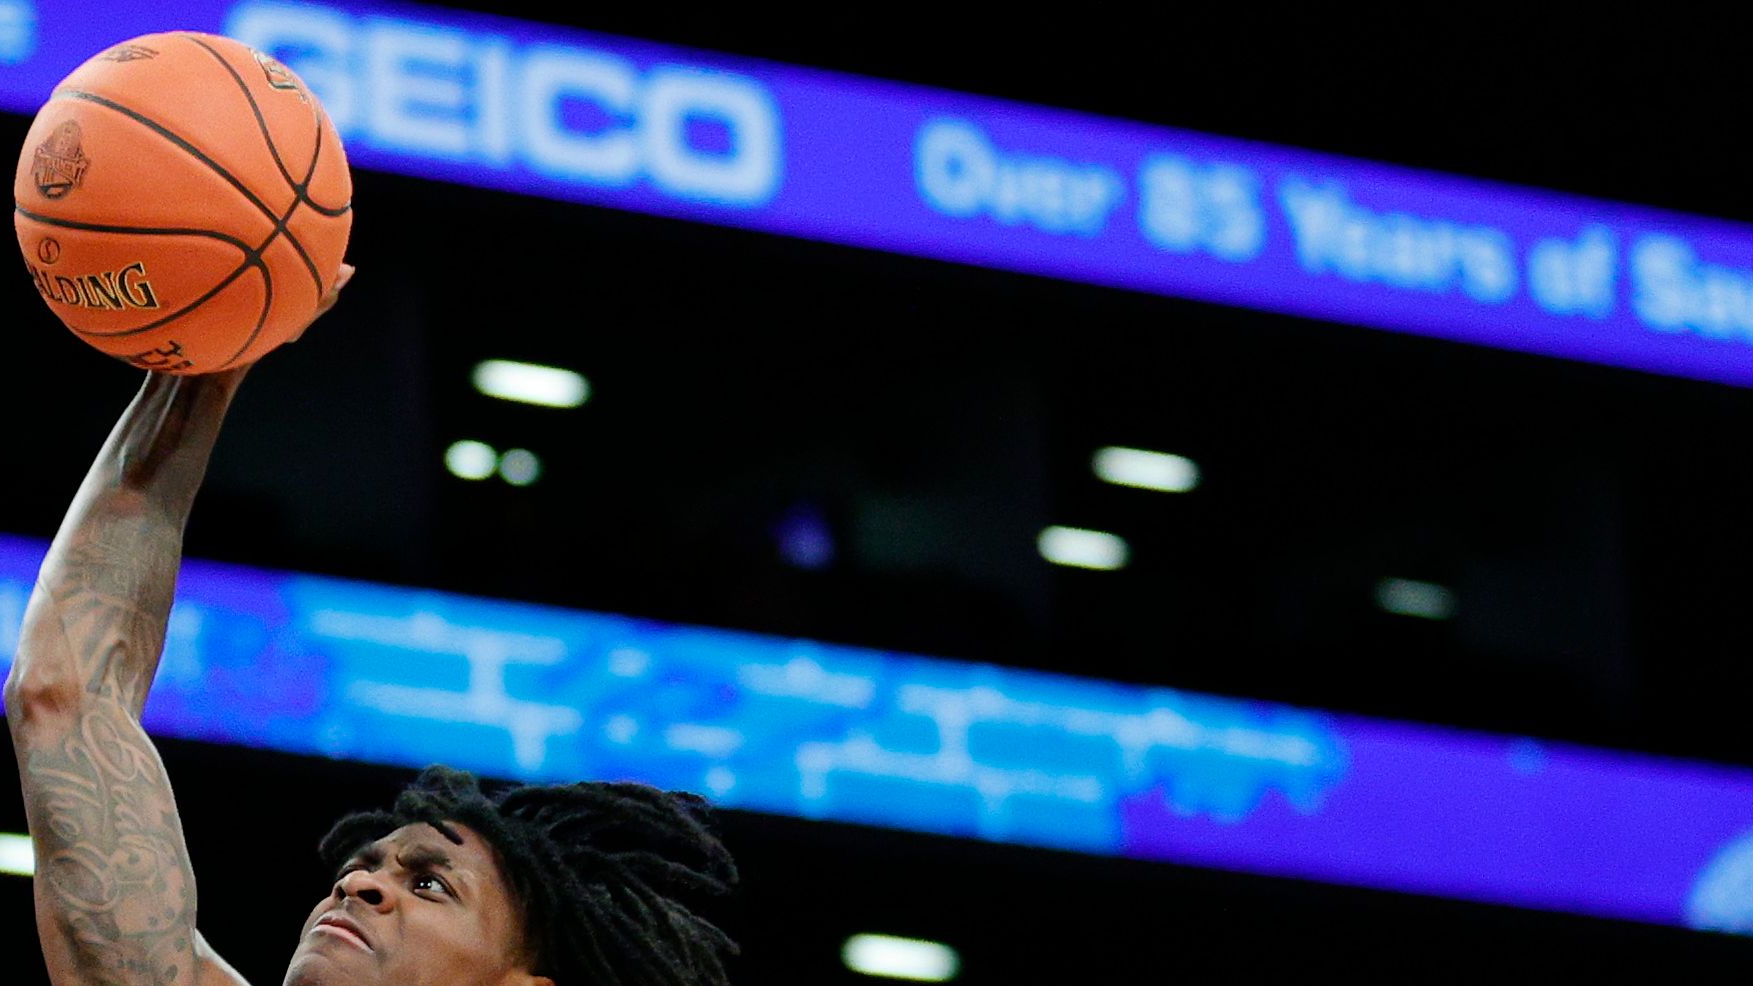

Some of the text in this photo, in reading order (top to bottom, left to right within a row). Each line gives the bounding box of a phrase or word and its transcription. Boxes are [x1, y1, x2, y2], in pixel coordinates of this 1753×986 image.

[225, 0, 785, 206] GEICO
[27, 261, 160, 310] ALDING
[915, 117, 1123, 237] Over
[1138, 153, 1265, 262] 85
[1278, 170, 1516, 303] Years
[1528, 223, 1617, 320] of
